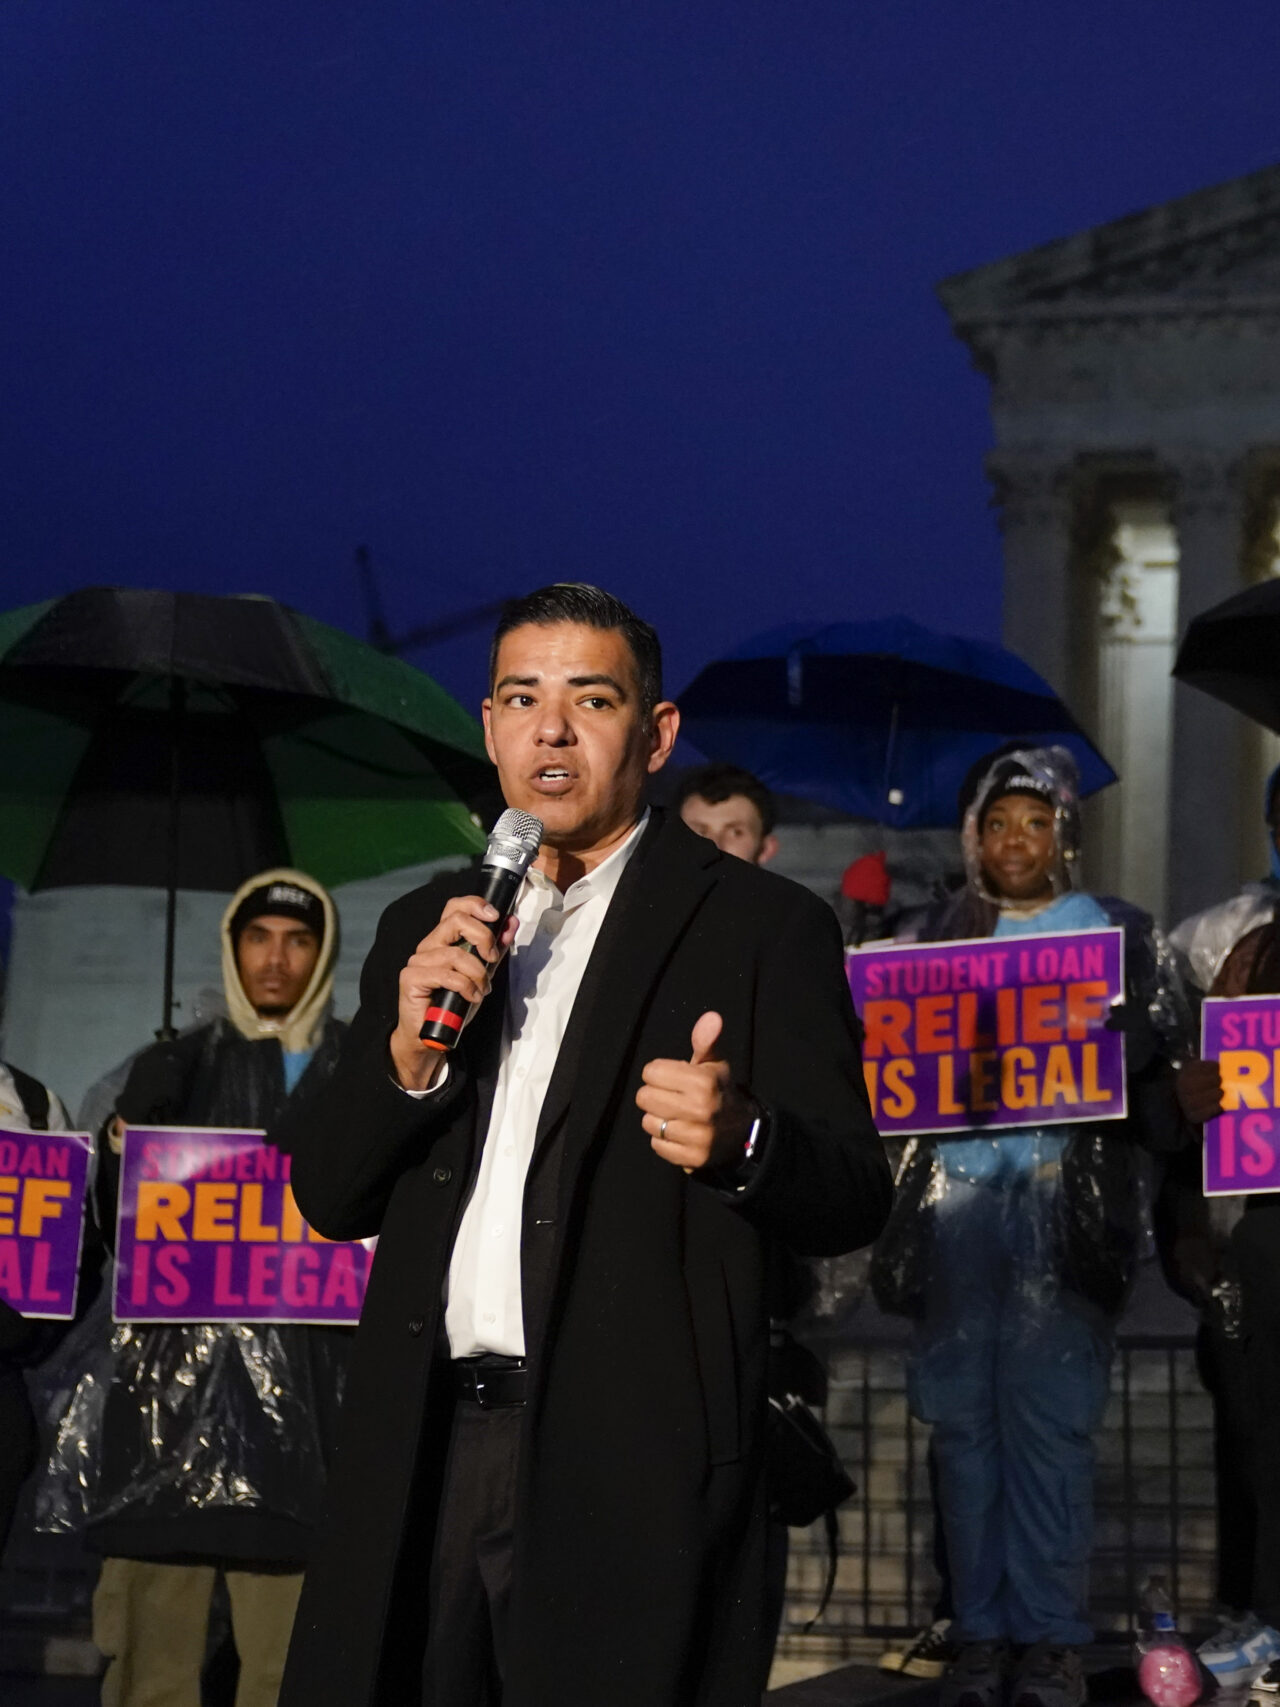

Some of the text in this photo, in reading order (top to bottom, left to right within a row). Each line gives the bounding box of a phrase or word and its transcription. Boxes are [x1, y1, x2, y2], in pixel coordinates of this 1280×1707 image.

[865, 944, 1104, 996] STUDENT LOAN
[863, 981, 1108, 1059] RELIEF
[863, 1043, 1112, 1119] IS LEGAL
[0, 1141, 70, 1178] OAN
[1219, 1113, 1276, 1178] IS
[135, 1181, 362, 1244] RELI
[131, 1244, 191, 1307] IS
[213, 1244, 375, 1308] LEGA
